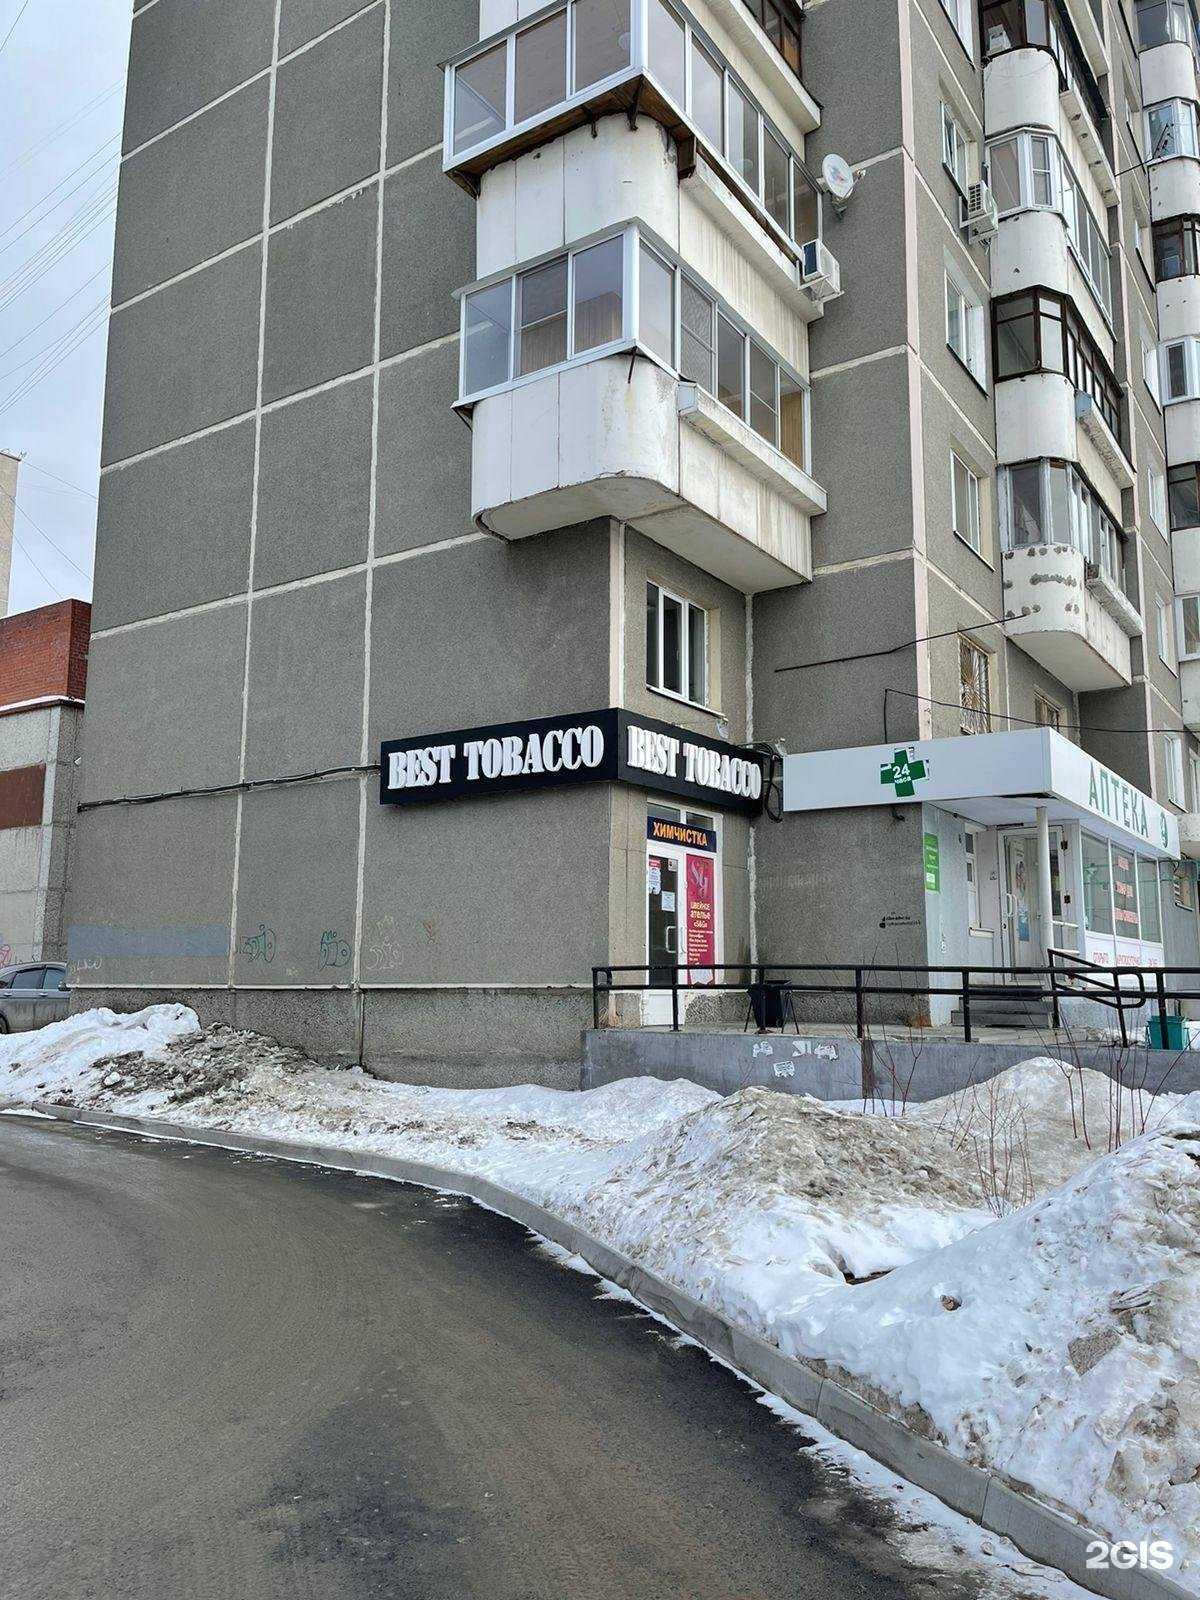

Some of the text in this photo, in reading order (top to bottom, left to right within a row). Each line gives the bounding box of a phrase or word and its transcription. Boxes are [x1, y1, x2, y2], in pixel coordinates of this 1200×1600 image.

[388, 725, 604, 789] BEST TOBACCO
[627, 725, 762, 800] BEST TOBACCO
[892, 763, 911, 779] 24
[1088, 761, 1149, 838] АПТЕКА
[653, 821, 708, 846] ХИМЧИСТКА
